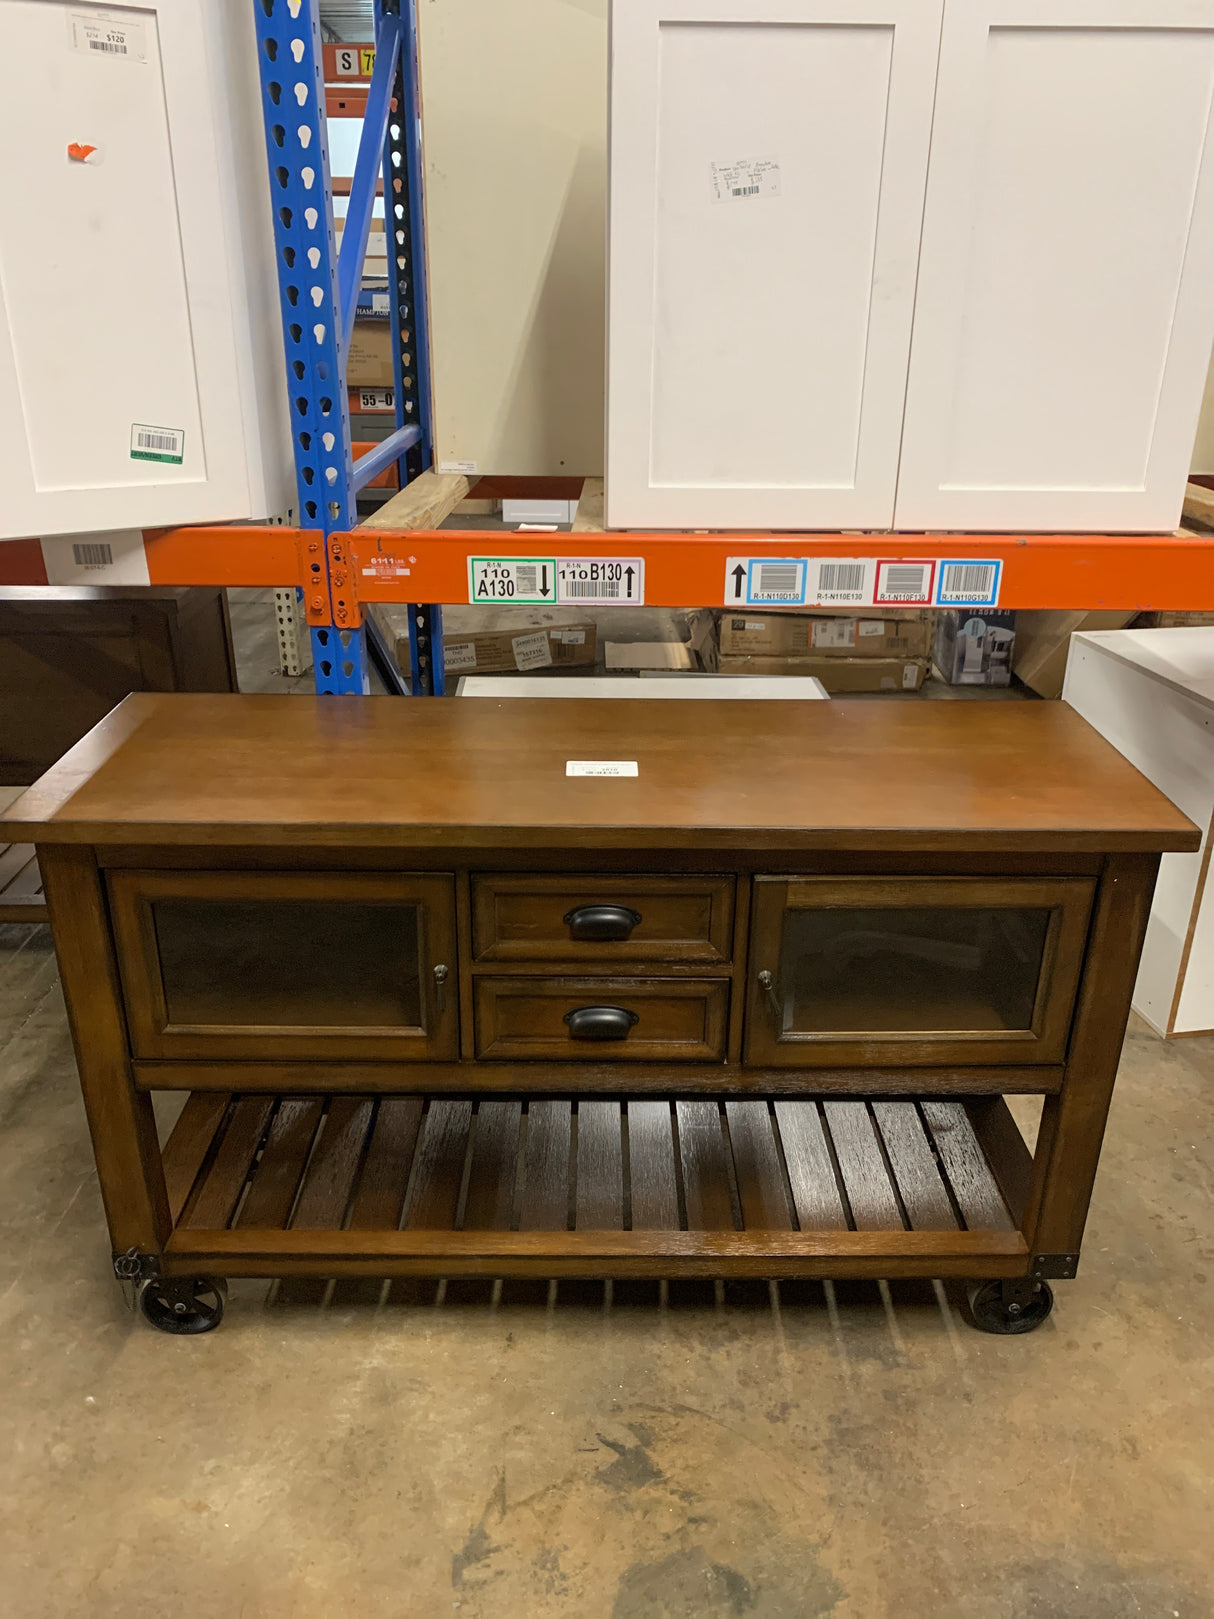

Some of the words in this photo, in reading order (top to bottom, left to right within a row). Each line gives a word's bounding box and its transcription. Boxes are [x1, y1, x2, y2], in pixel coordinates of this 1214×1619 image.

[106, 34, 125, 43] $120
[341, 52, 352, 70] S
[481, 569, 510, 578] 110
[559, 570, 588, 580] 110
[590, 563, 622, 581] B130
[477, 580, 515, 597] A130
[941, 594, 989, 602] R-1-N110G130
